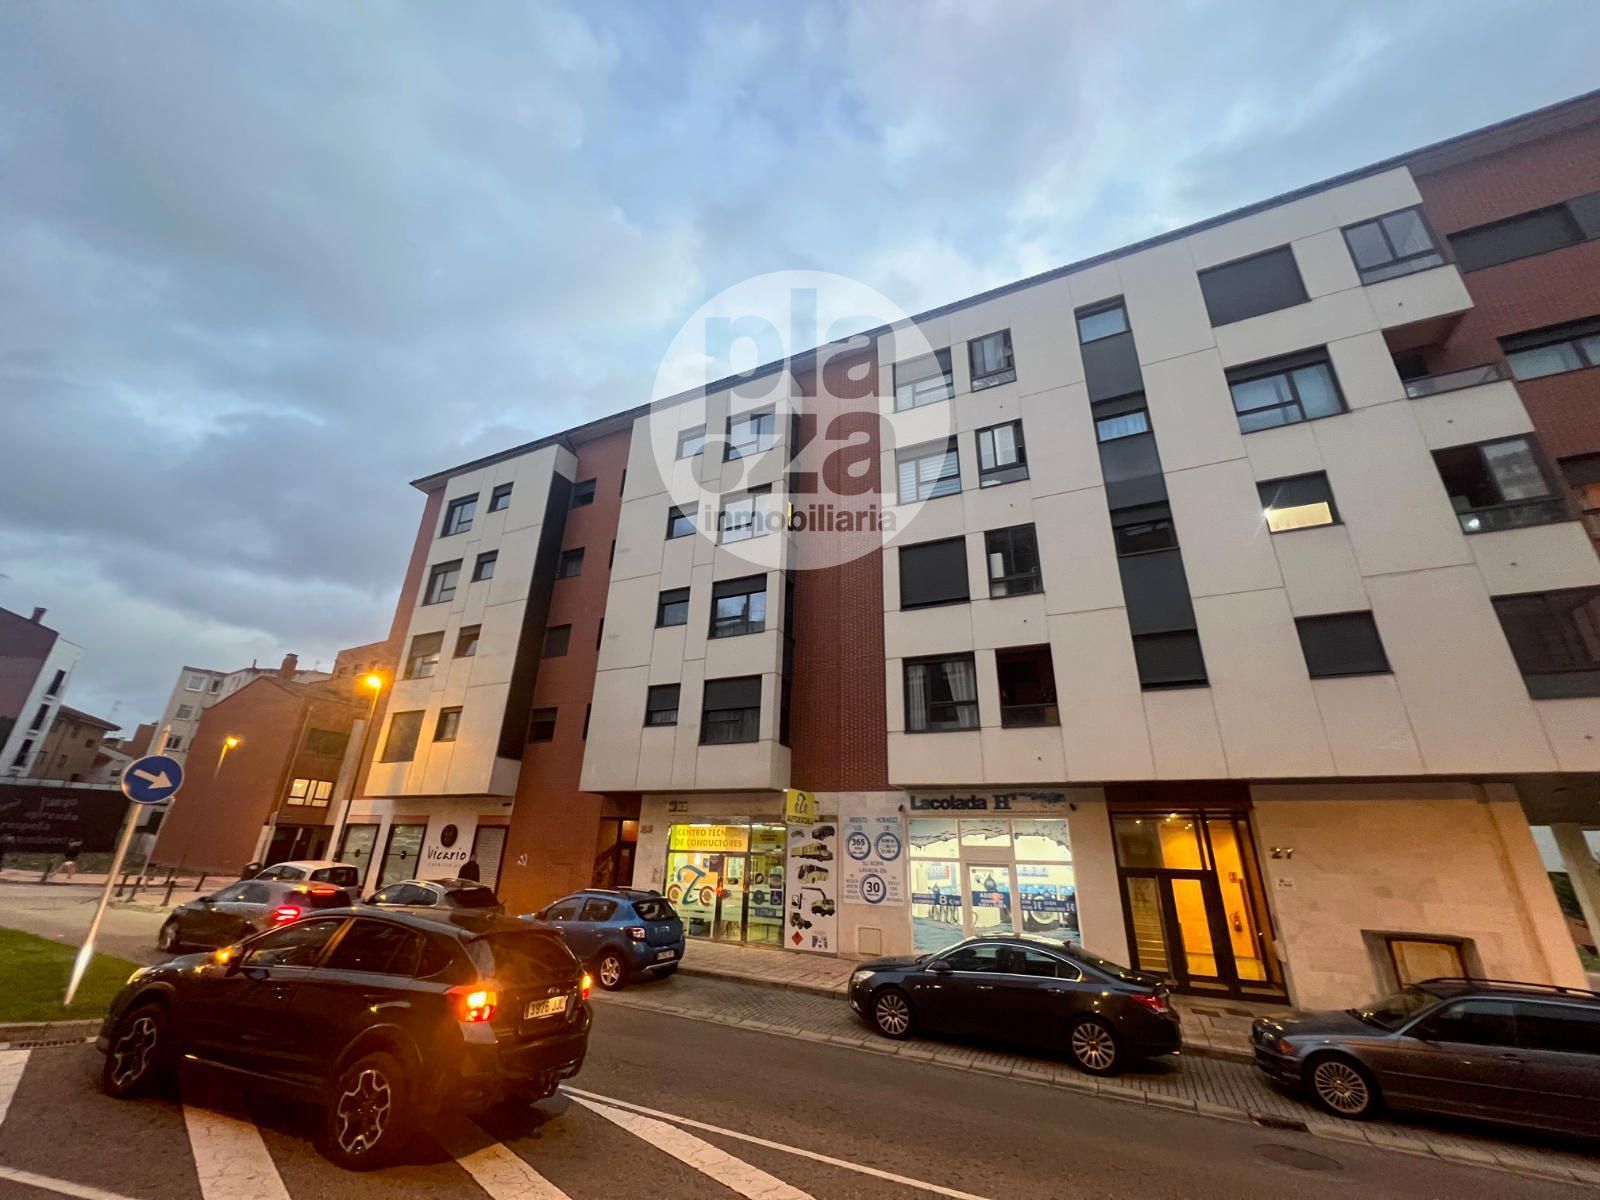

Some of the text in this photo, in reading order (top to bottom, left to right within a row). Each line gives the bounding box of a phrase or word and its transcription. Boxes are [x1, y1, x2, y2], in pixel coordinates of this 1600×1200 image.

[910, 794, 987, 810] Lacolada
[678, 828, 706, 837] CENTRO
[675, 838, 743, 848] DE CONDUCTORES
[852, 838, 866, 846] 365
[427, 845, 467, 860] Vicario
[866, 882, 880, 893] 30
